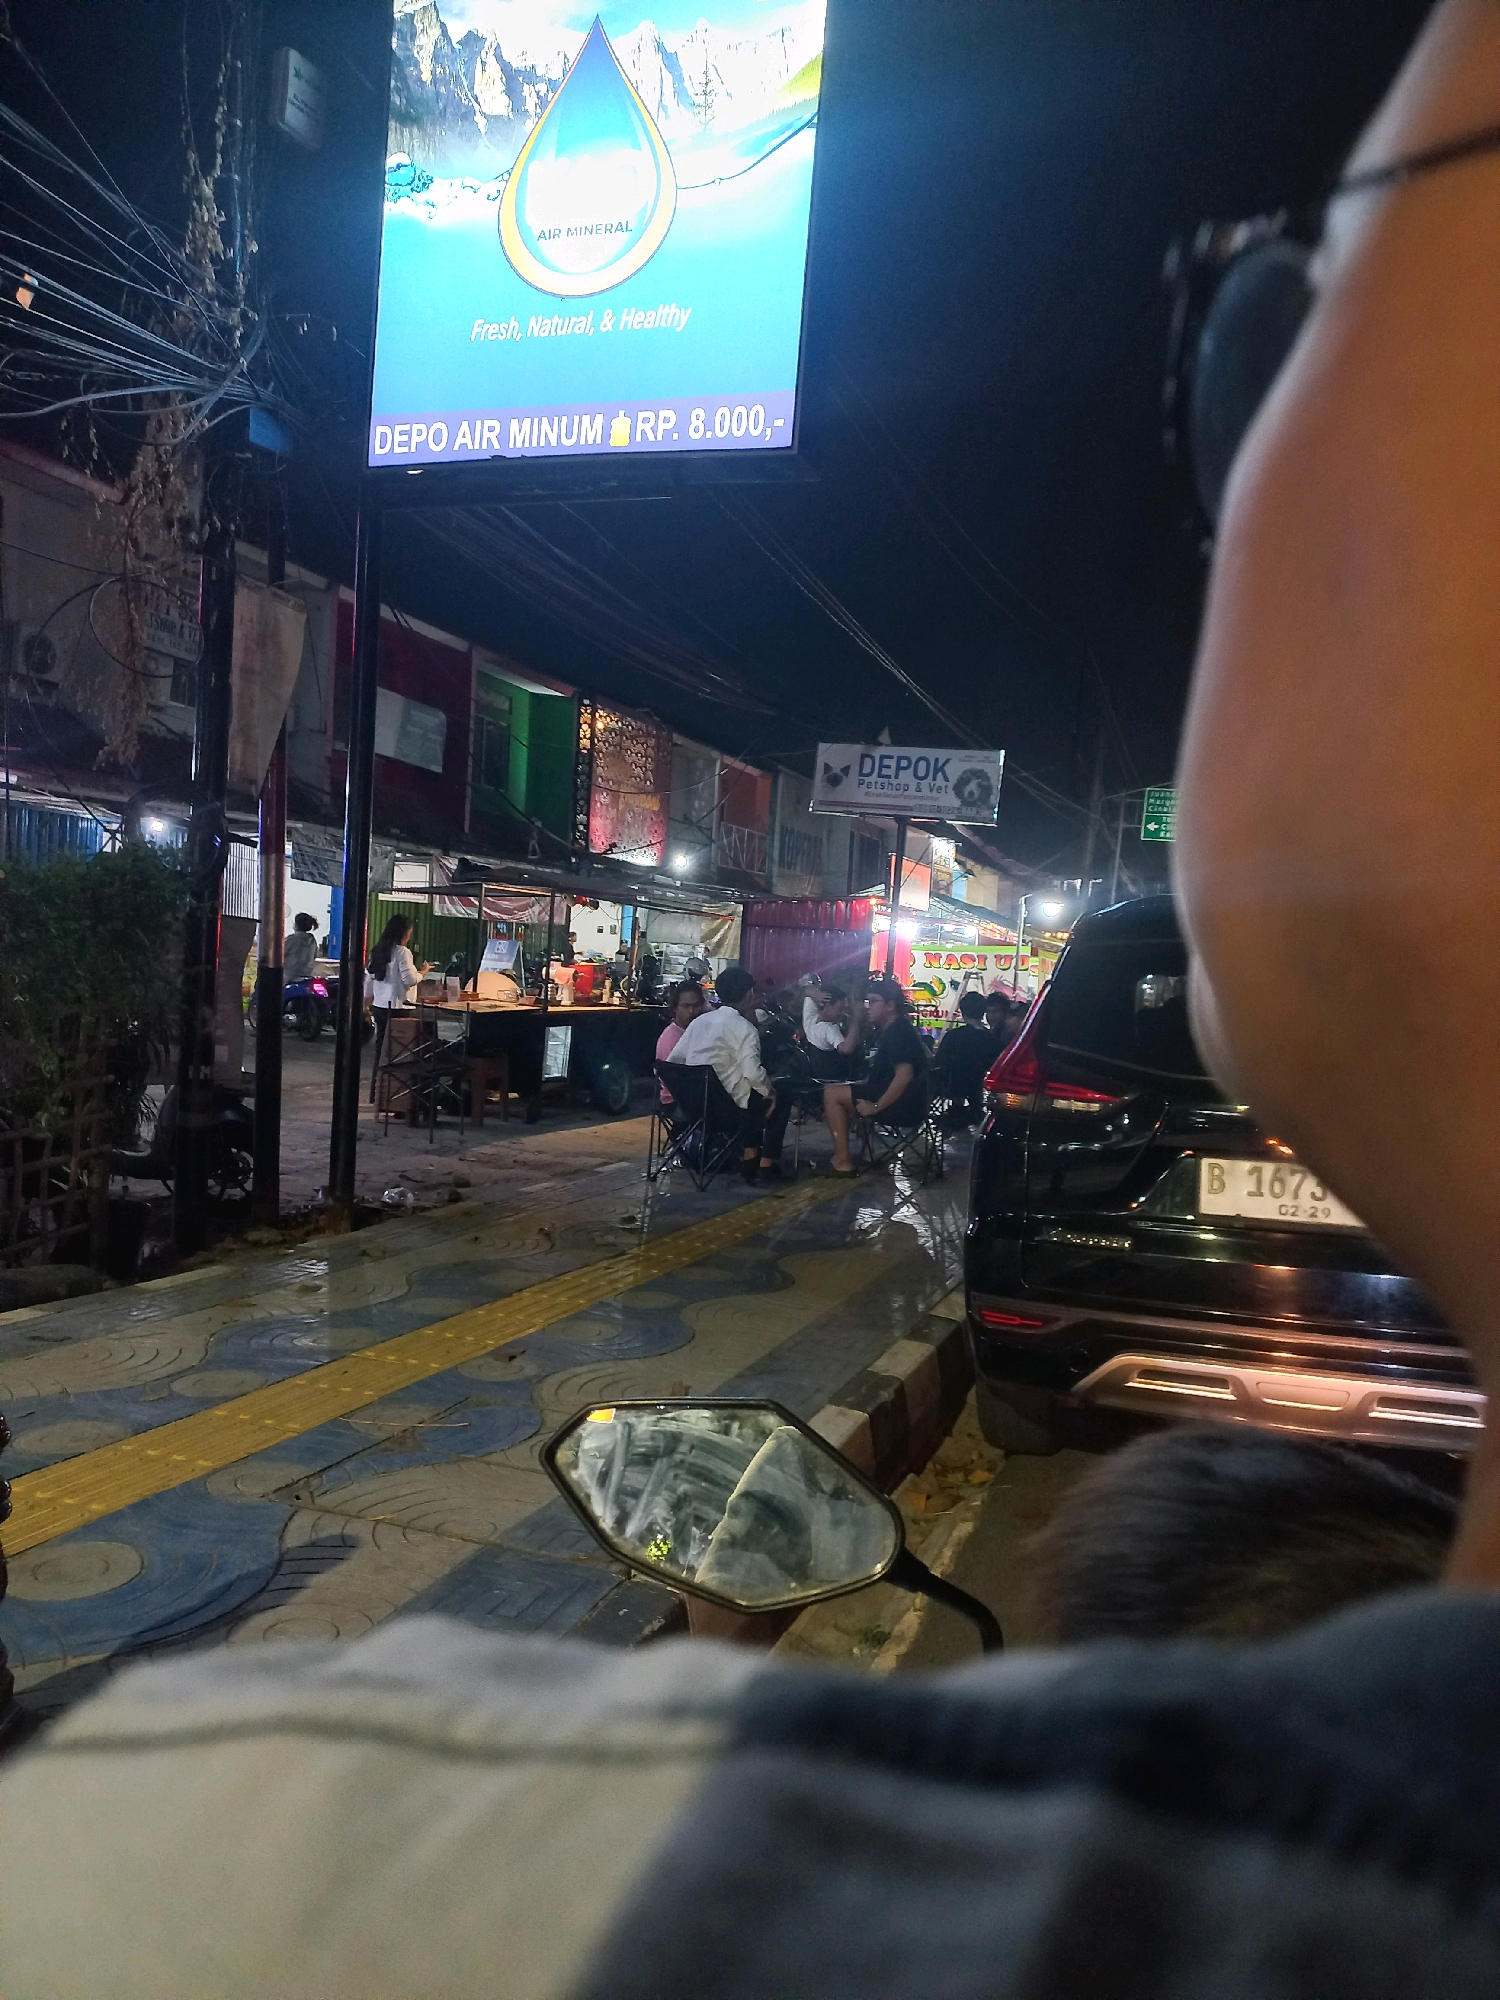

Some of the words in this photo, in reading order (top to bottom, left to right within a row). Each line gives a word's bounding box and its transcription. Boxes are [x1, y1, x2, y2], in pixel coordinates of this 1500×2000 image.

[537, 227, 561, 241] AIR
[566, 221, 633, 237] MINERAL
[470, 316, 522, 342] Fresh,
[527, 310, 595, 337] Natural,
[600, 309, 616, 331] &
[619, 302, 692, 332] Healthy
[374, 421, 449, 455] DEPO
[453, 419, 501, 451] AIR
[508, 413, 604, 448] MINUM
[635, 409, 680, 442] RP.
[688, 404, 785, 442] 8.000,-
[858, 753, 952, 782] DEPOK
[857, 779, 910, 793] Petshop
[914, 782, 923, 793] &
[928, 783, 949, 794] Vet
[924, 952, 988, 970] NASI
[1208, 1163, 1226, 1194] B
